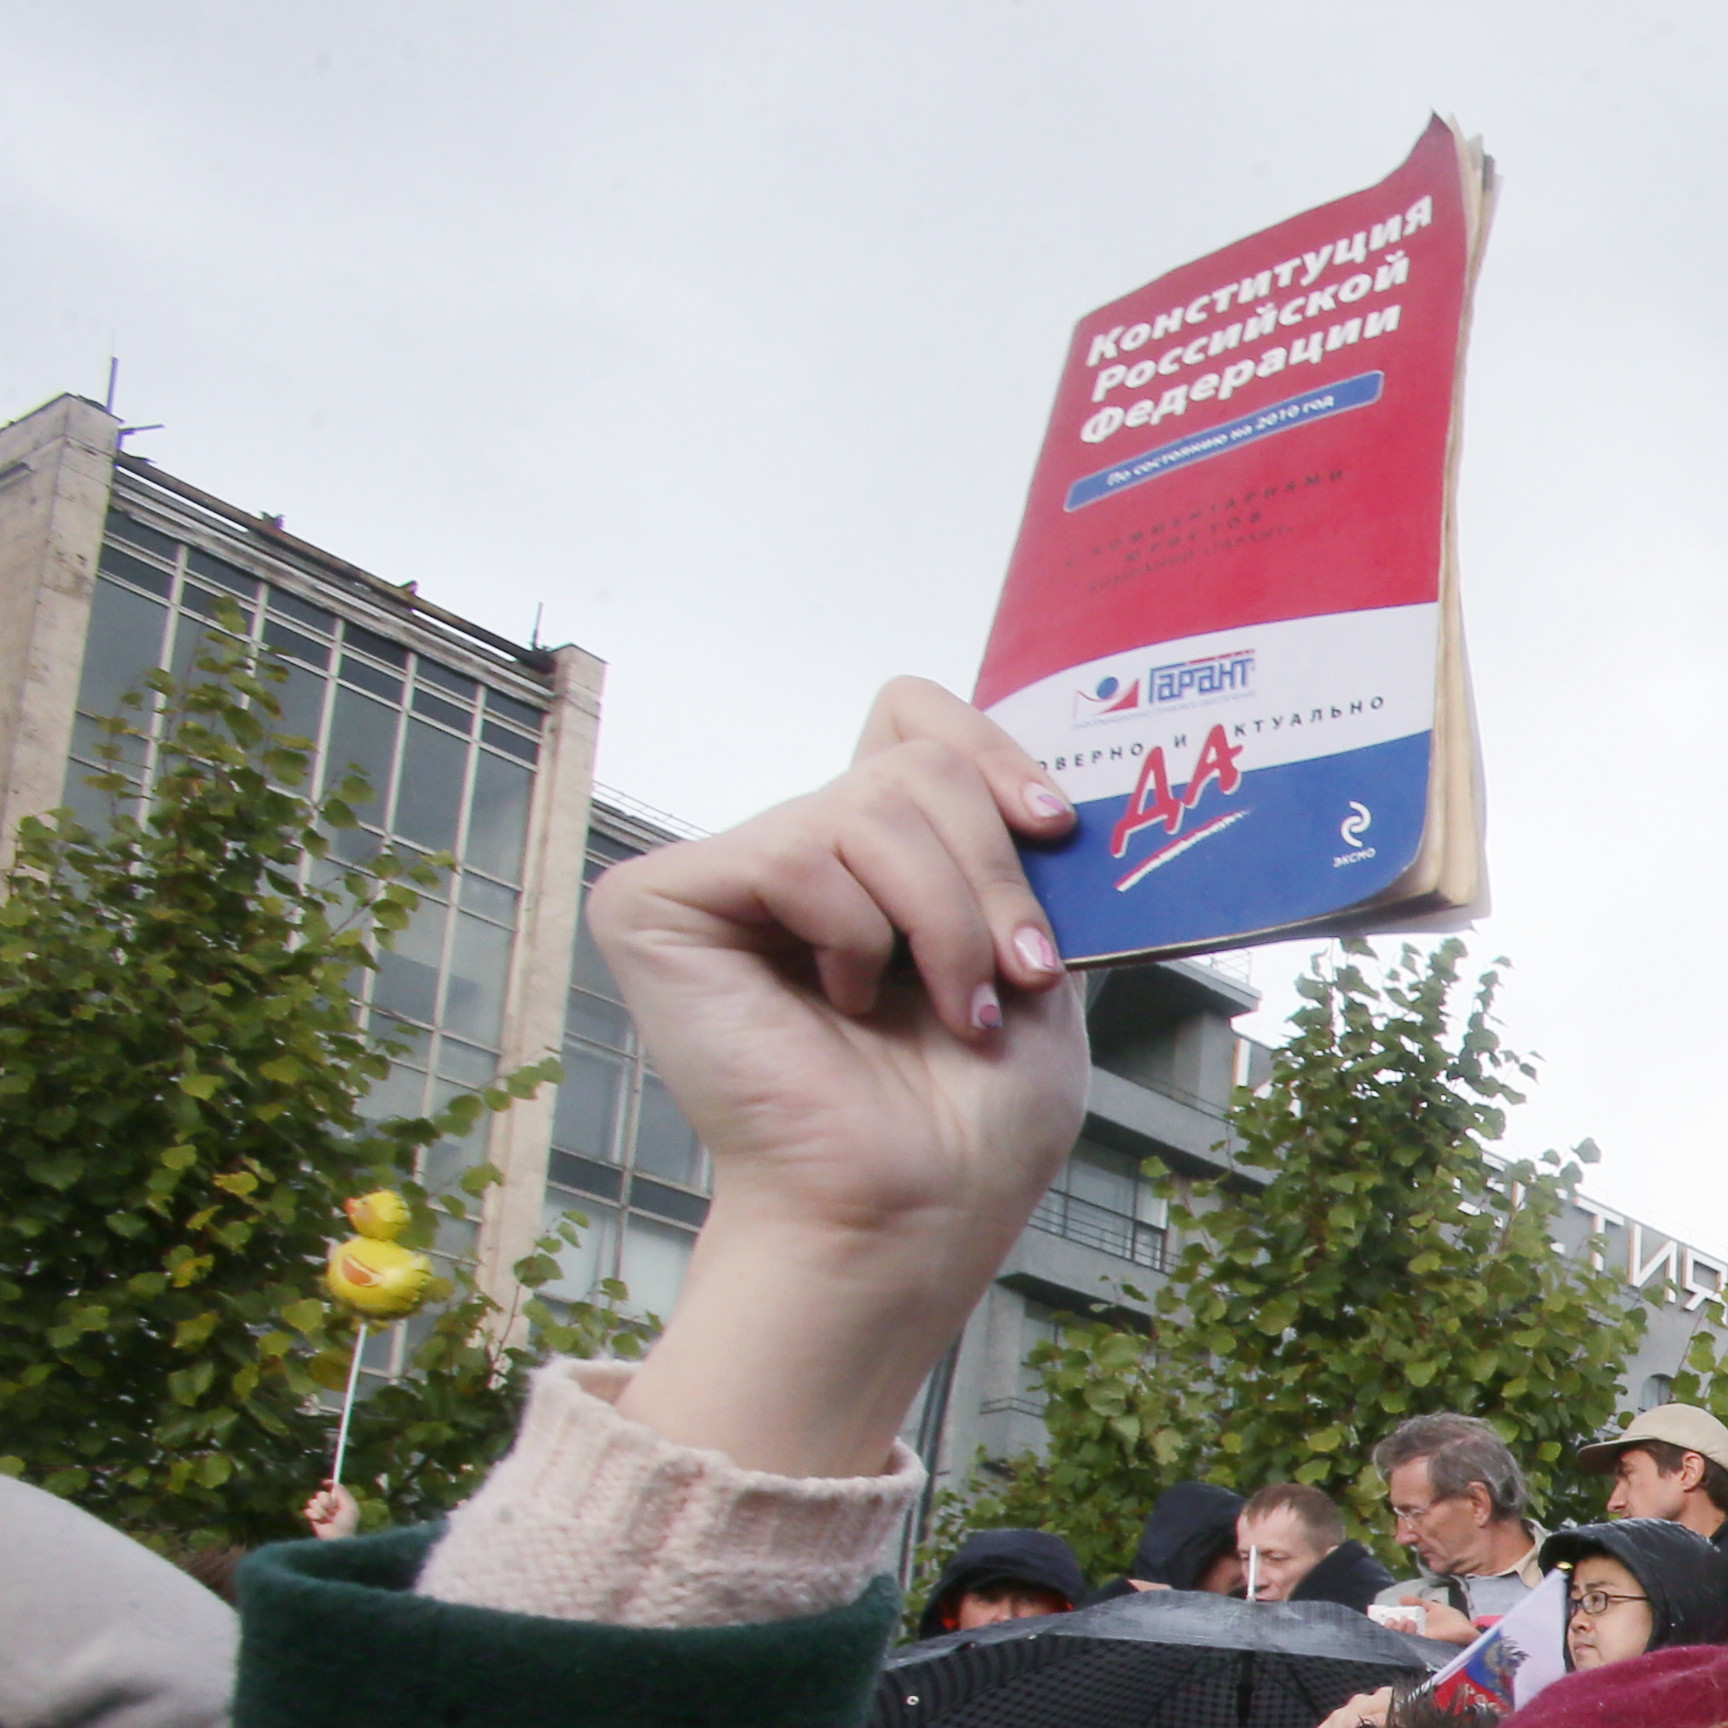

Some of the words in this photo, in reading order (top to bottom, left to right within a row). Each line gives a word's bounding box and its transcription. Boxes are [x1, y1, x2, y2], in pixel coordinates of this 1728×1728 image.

[1085, 195, 1433, 367] Конституция
[1091, 250, 1410, 403] Российской
[1080, 305, 1402, 444] Федерации
